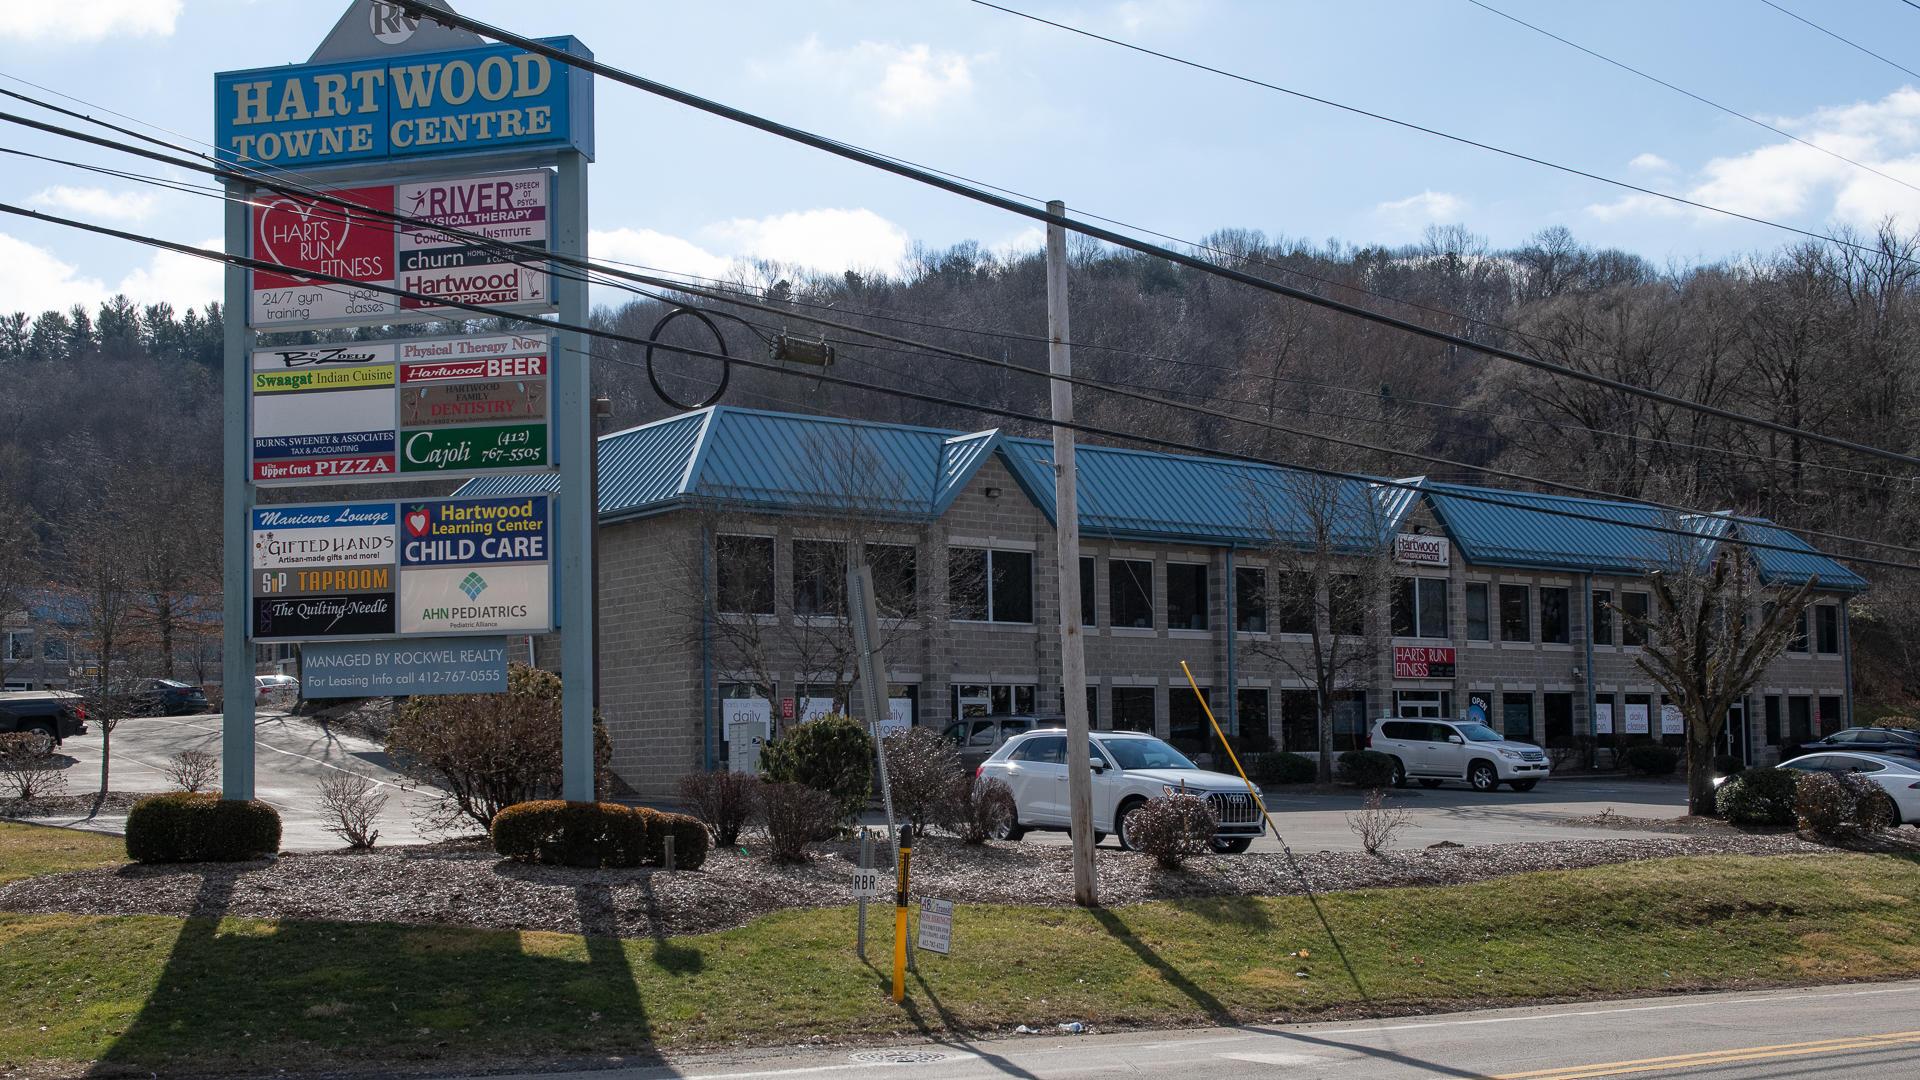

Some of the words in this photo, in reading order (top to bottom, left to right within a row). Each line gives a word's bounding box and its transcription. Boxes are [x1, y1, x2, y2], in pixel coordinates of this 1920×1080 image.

[232, 54, 552, 126] HARTWOOD
[232, 124, 373, 163] TOWNE
[390, 106, 552, 148] CENTRE
[515, 181, 540, 190] SPEECH
[430, 181, 514, 216] RIVER
[474, 209, 532, 223] THERAPY
[273, 221, 330, 244] HARTS
[483, 227, 532, 239] INSTITUTE
[300, 240, 335, 261] RUN
[320, 256, 383, 278] FITNESS
[407, 251, 464, 269] churn
[405, 268, 518, 295] Hartwood
[261, 290, 294, 306] 24/7
[297, 291, 323, 306] gym
[267, 306, 310, 320] training
[345, 301, 385, 314] classes
[404, 343, 453, 359] Physical
[457, 341, 508, 354] Therapy
[511, 337, 541, 350] Now
[409, 364, 485, 379] Hartwood
[486, 357, 541, 377] BEER
[256, 371, 313, 389] Swaagat
[317, 372, 350, 384] Indian
[353, 369, 393, 381] Cuisine
[445, 383, 500, 394] HARTWOOD
[456, 393, 490, 402] FAMILY
[431, 399, 517, 417] DENTISTRY
[256, 438, 288, 448] BURNS,
[289, 436, 331, 446] SWEENEY
[332, 435, 340, 444] &
[341, 431, 395, 444] ASSOCIATES
[291, 447, 305, 455] TAX
[312, 444, 359, 454] ACCOUNTING
[405, 431, 472, 469] Cajoli
[497, 430, 530, 446] (412)
[481, 446, 542, 463] 767-5505
[261, 465, 288, 478] Upper
[289, 464, 312, 475] Crust
[314, 458, 390, 475] PIZZA
[260, 511, 331, 527] Manicure
[335, 508, 389, 526] Lounge
[441, 500, 533, 521] Hartwood
[432, 521, 493, 536] Learning
[496, 519, 543, 532] Center
[268, 539, 330, 556] GIFTED
[333, 535, 394, 552] HANDS
[405, 539, 476, 562] CHILD
[481, 536, 544, 559] CARE
[1398, 538, 1440, 553] Hartwood
[278, 555, 325, 564] Artisan-made
[326, 554, 343, 563] gifts
[359, 551, 380, 560] more!
[297, 567, 389, 593] TAPROOM
[272, 602, 294, 616] The
[297, 600, 346, 620] Quilting
[347, 599, 388, 615] Needle
[422, 607, 449, 620] AHN
[451, 605, 527, 619] PEDIATRICS
[305, 653, 371, 668] MANAGED
[375, 652, 391, 666] BY
[394, 650, 457, 665] ROCKWEL
[460, 649, 504, 663] REALTY
[1395, 647, 1426, 662] HARTS
[1428, 648, 1448, 662] RUN
[308, 676, 325, 687] For
[328, 673, 369, 688] Leasing
[372, 673, 393, 685] Info
[396, 671, 415, 684] call
[418, 669, 500, 684] 412-767-0555
[1396, 663, 1429, 677] FITNESS
[1471, 697, 1488, 712] OPEN
[854, 875, 876, 890] RBR
